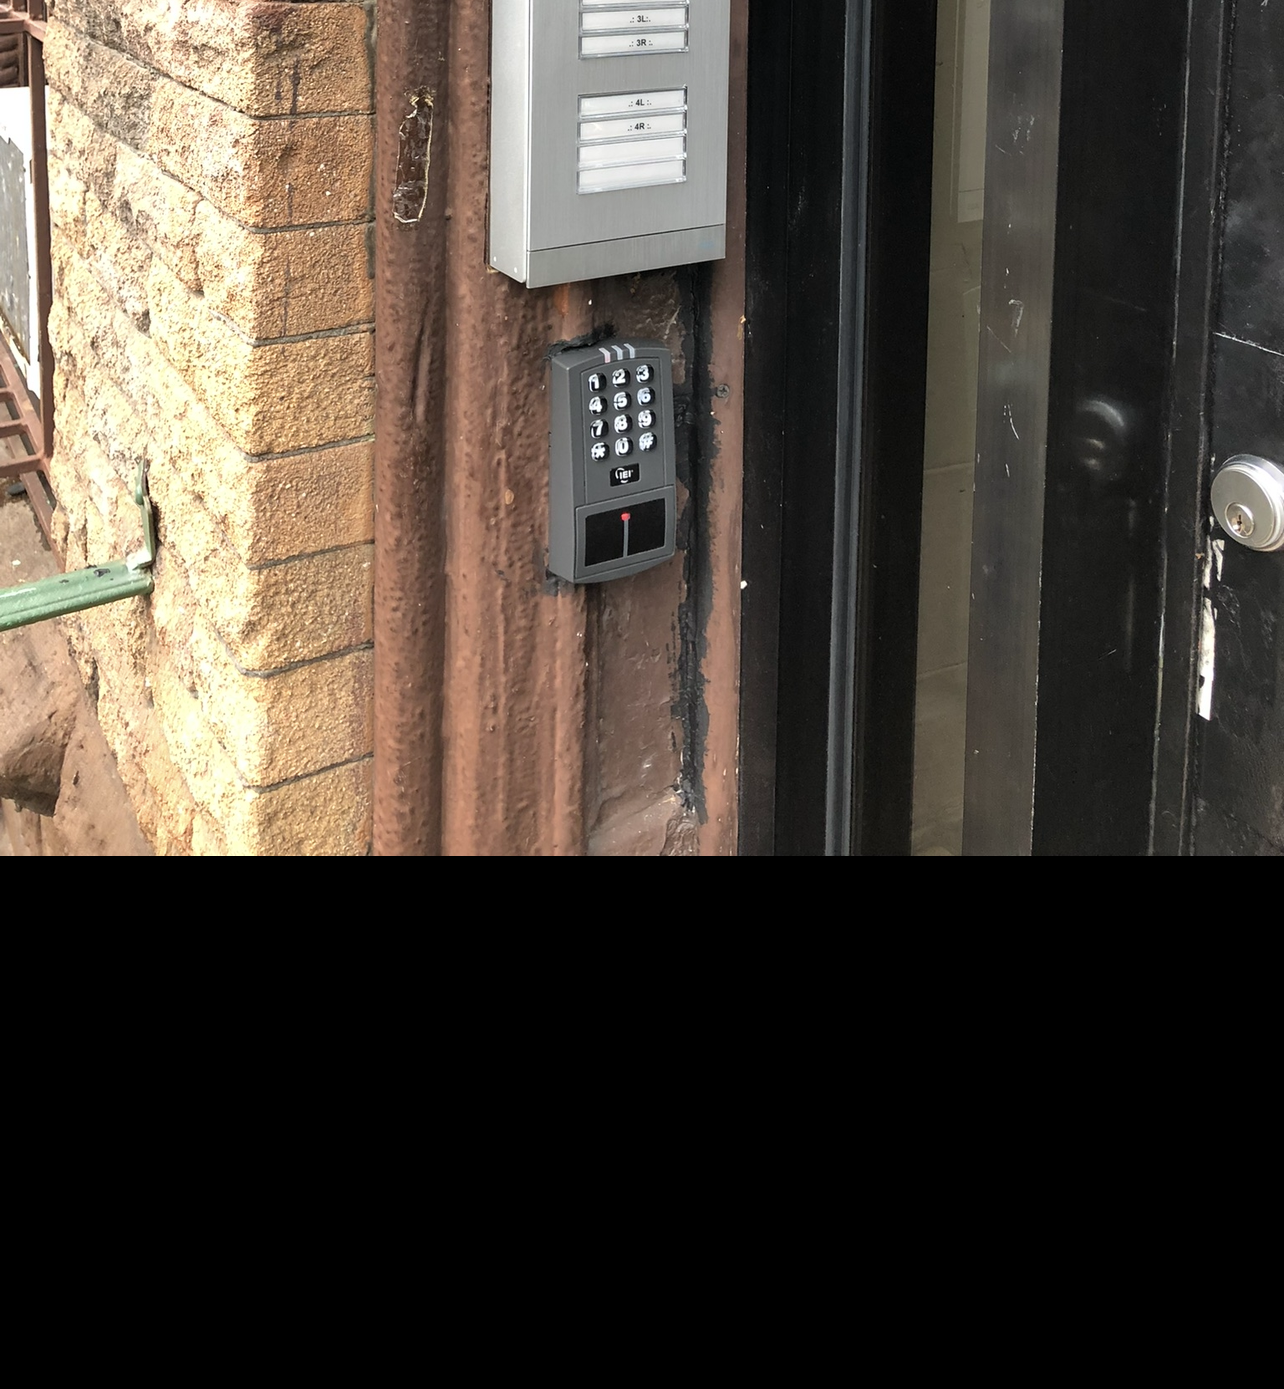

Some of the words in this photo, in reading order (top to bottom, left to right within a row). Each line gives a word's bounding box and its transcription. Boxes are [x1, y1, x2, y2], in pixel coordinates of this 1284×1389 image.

[636, 39, 646, 47] 3R
[589, 373, 600, 390] 1
[612, 368, 626, 385] 2
[636, 364, 650, 382] 3
[589, 396, 602, 414] 4
[614, 391, 628, 409] 5
[637, 387, 651, 405] 6
[591, 419, 603, 436] 7
[614, 414, 628, 432] 8
[638, 409, 652, 427] 9
[615, 437, 629, 454] 0
